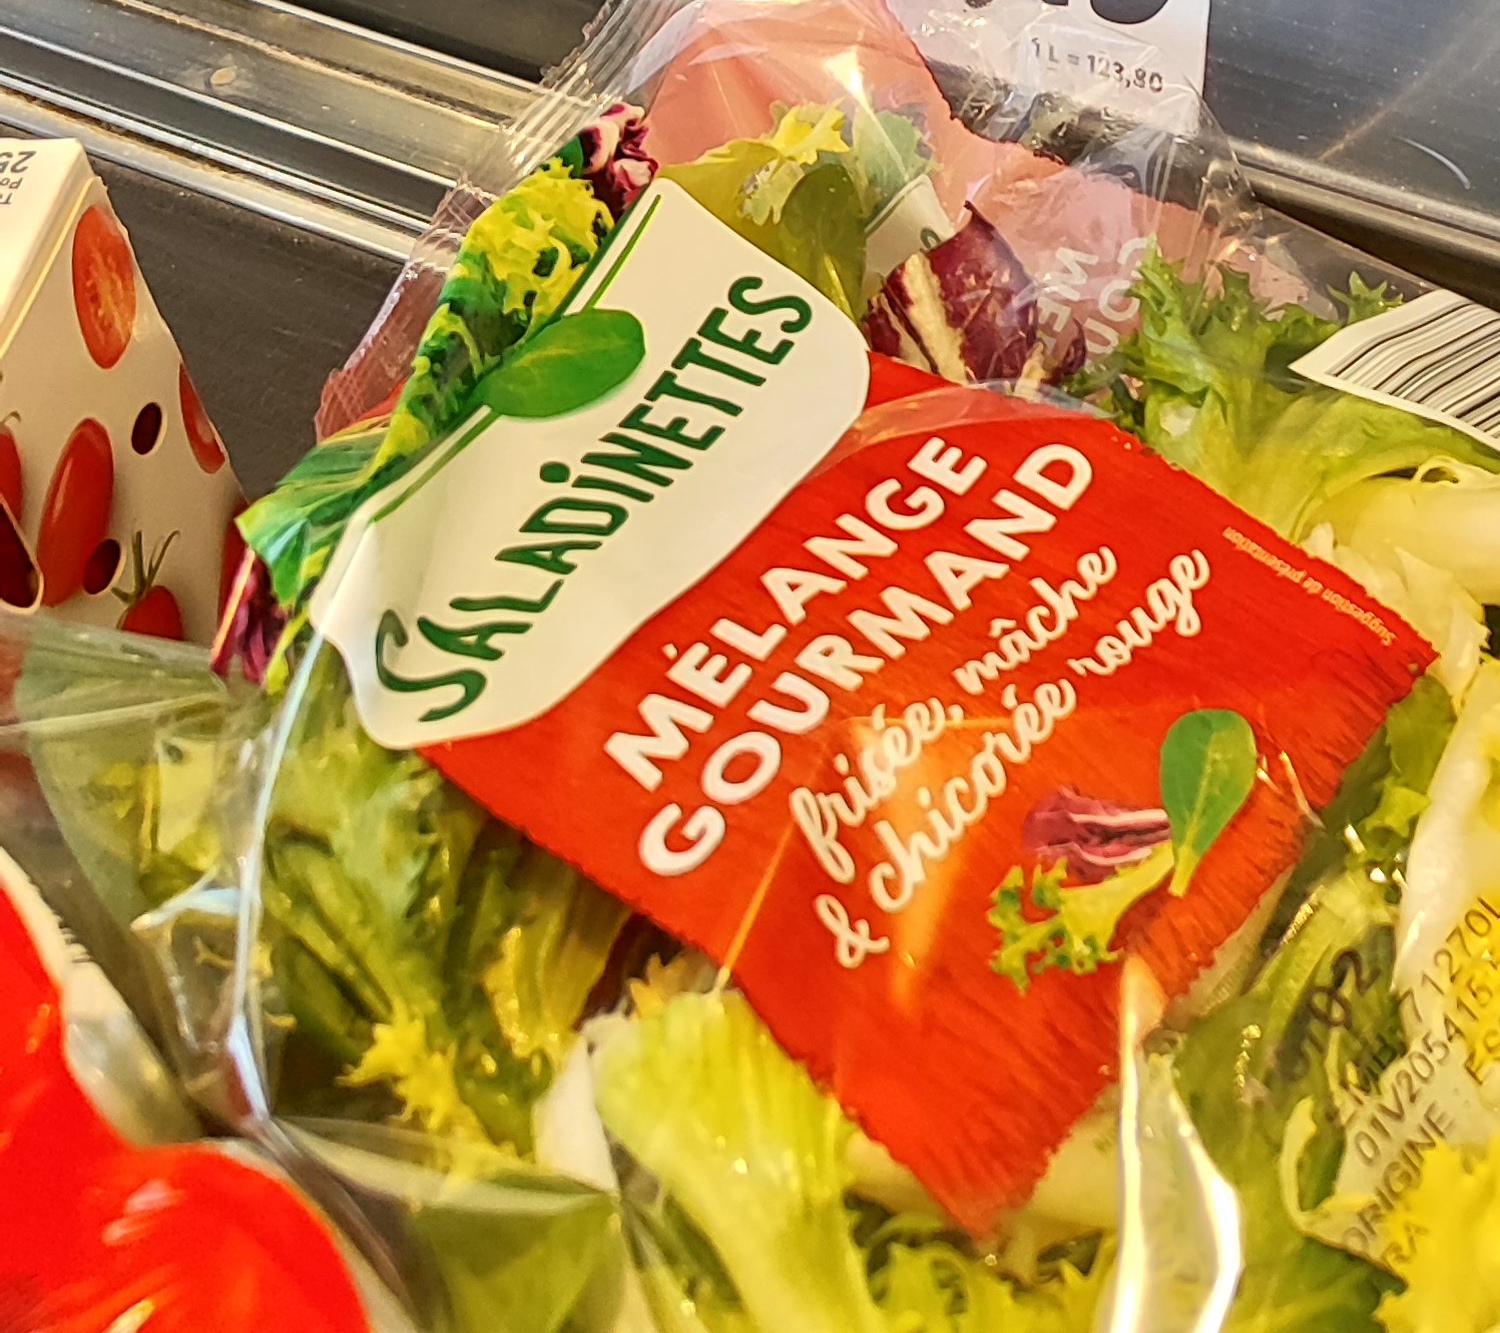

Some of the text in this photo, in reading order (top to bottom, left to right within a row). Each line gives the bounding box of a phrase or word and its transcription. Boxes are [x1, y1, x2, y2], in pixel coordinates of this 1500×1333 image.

[375, 275, 813, 723] SALADINETTES
[603, 435, 989, 793] MÉLANGE
[639, 441, 1094, 877] GOURMAND
[1222, 526, 1398, 648] Suggestion de présentation
[789, 545, 1119, 885] frisée, mâche
[813, 548, 1211, 970] & chicorée rouge
